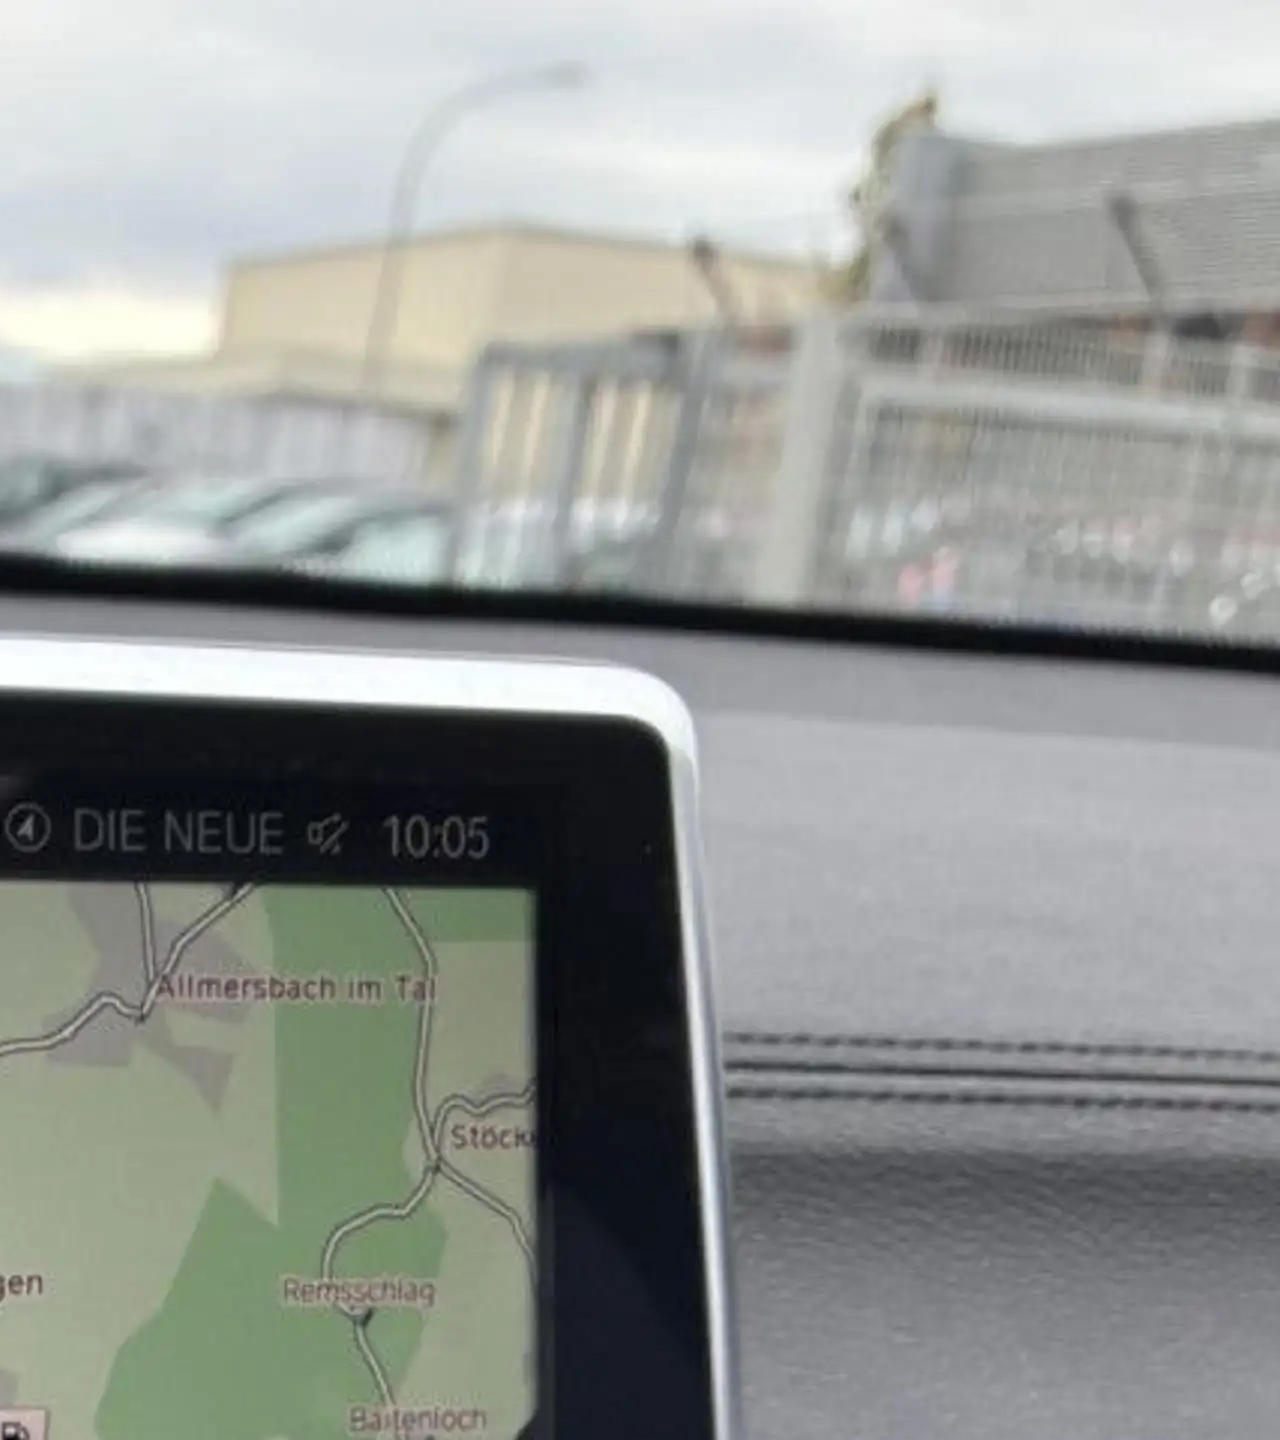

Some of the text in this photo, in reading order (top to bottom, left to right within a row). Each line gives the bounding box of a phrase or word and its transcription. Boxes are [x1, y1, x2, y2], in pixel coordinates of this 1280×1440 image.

[74, 809, 285, 855] DIE NEUE
[383, 815, 490, 860] 10:05
[158, 974, 336, 1000] Allmersbach
[348, 976, 382, 1000] im
